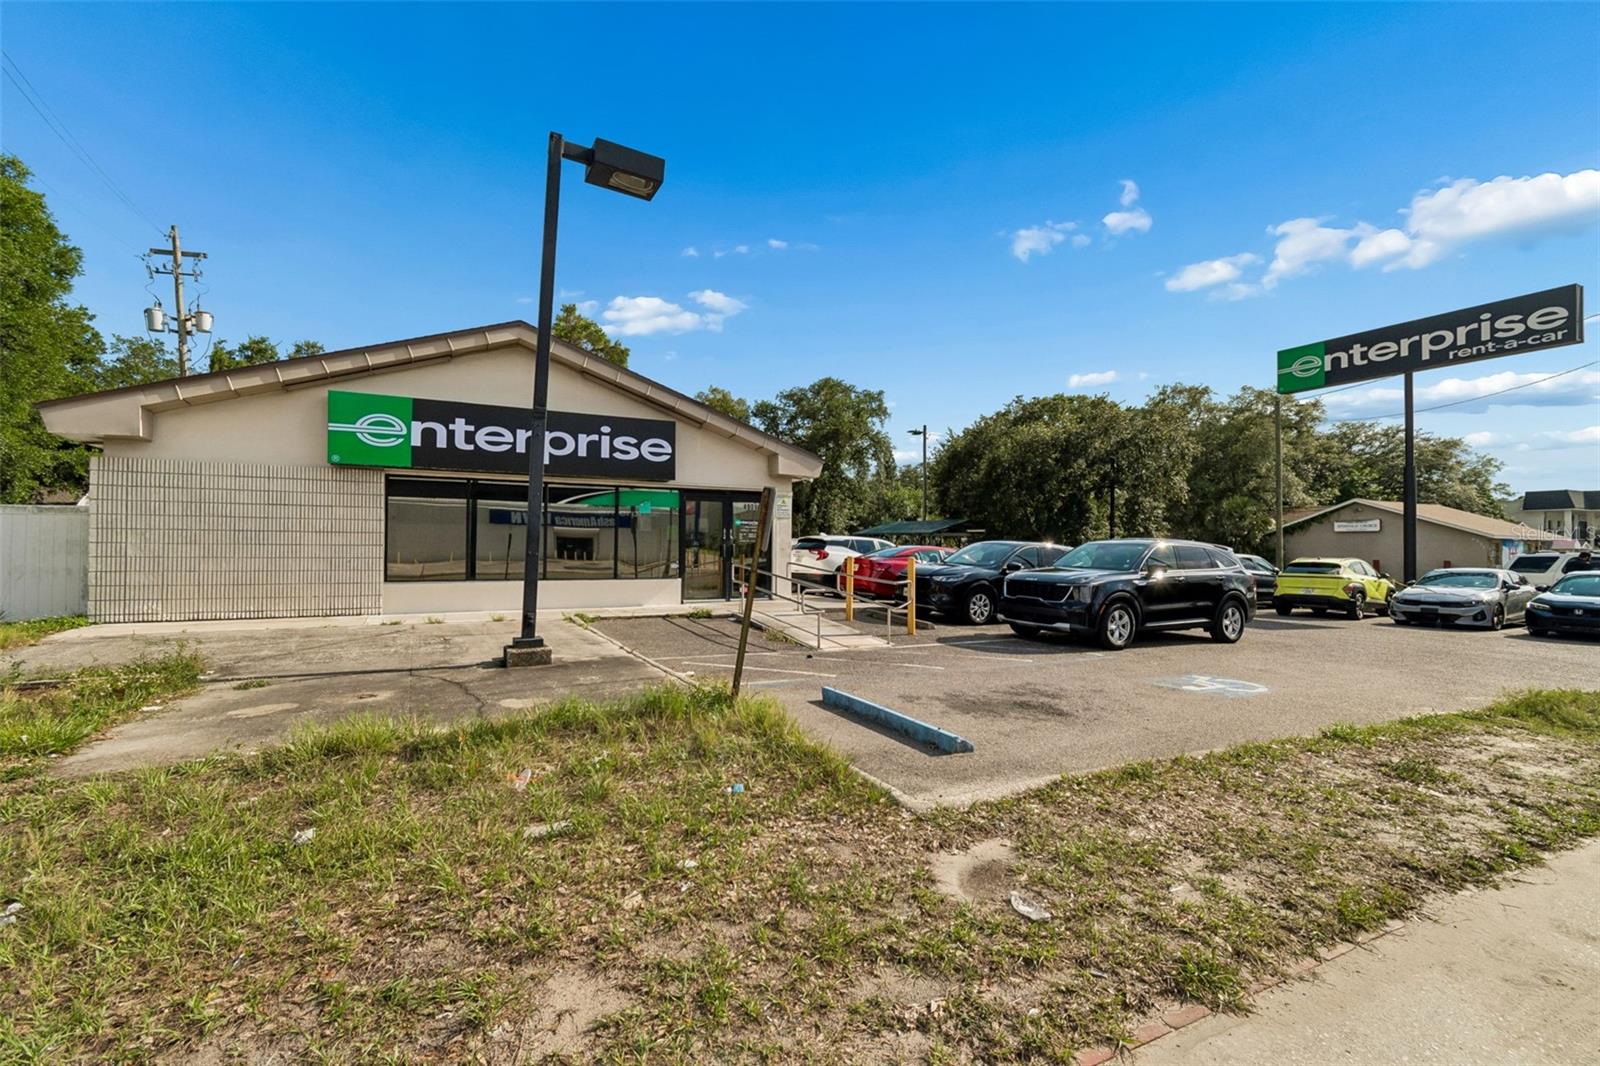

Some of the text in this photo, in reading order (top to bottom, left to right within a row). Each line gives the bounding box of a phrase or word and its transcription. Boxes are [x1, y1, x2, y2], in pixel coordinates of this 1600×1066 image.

[1278, 306, 1569, 378] enterprise
[1448, 327, 1568, 360] rent-a-car
[328, 412, 673, 464] enterprise
